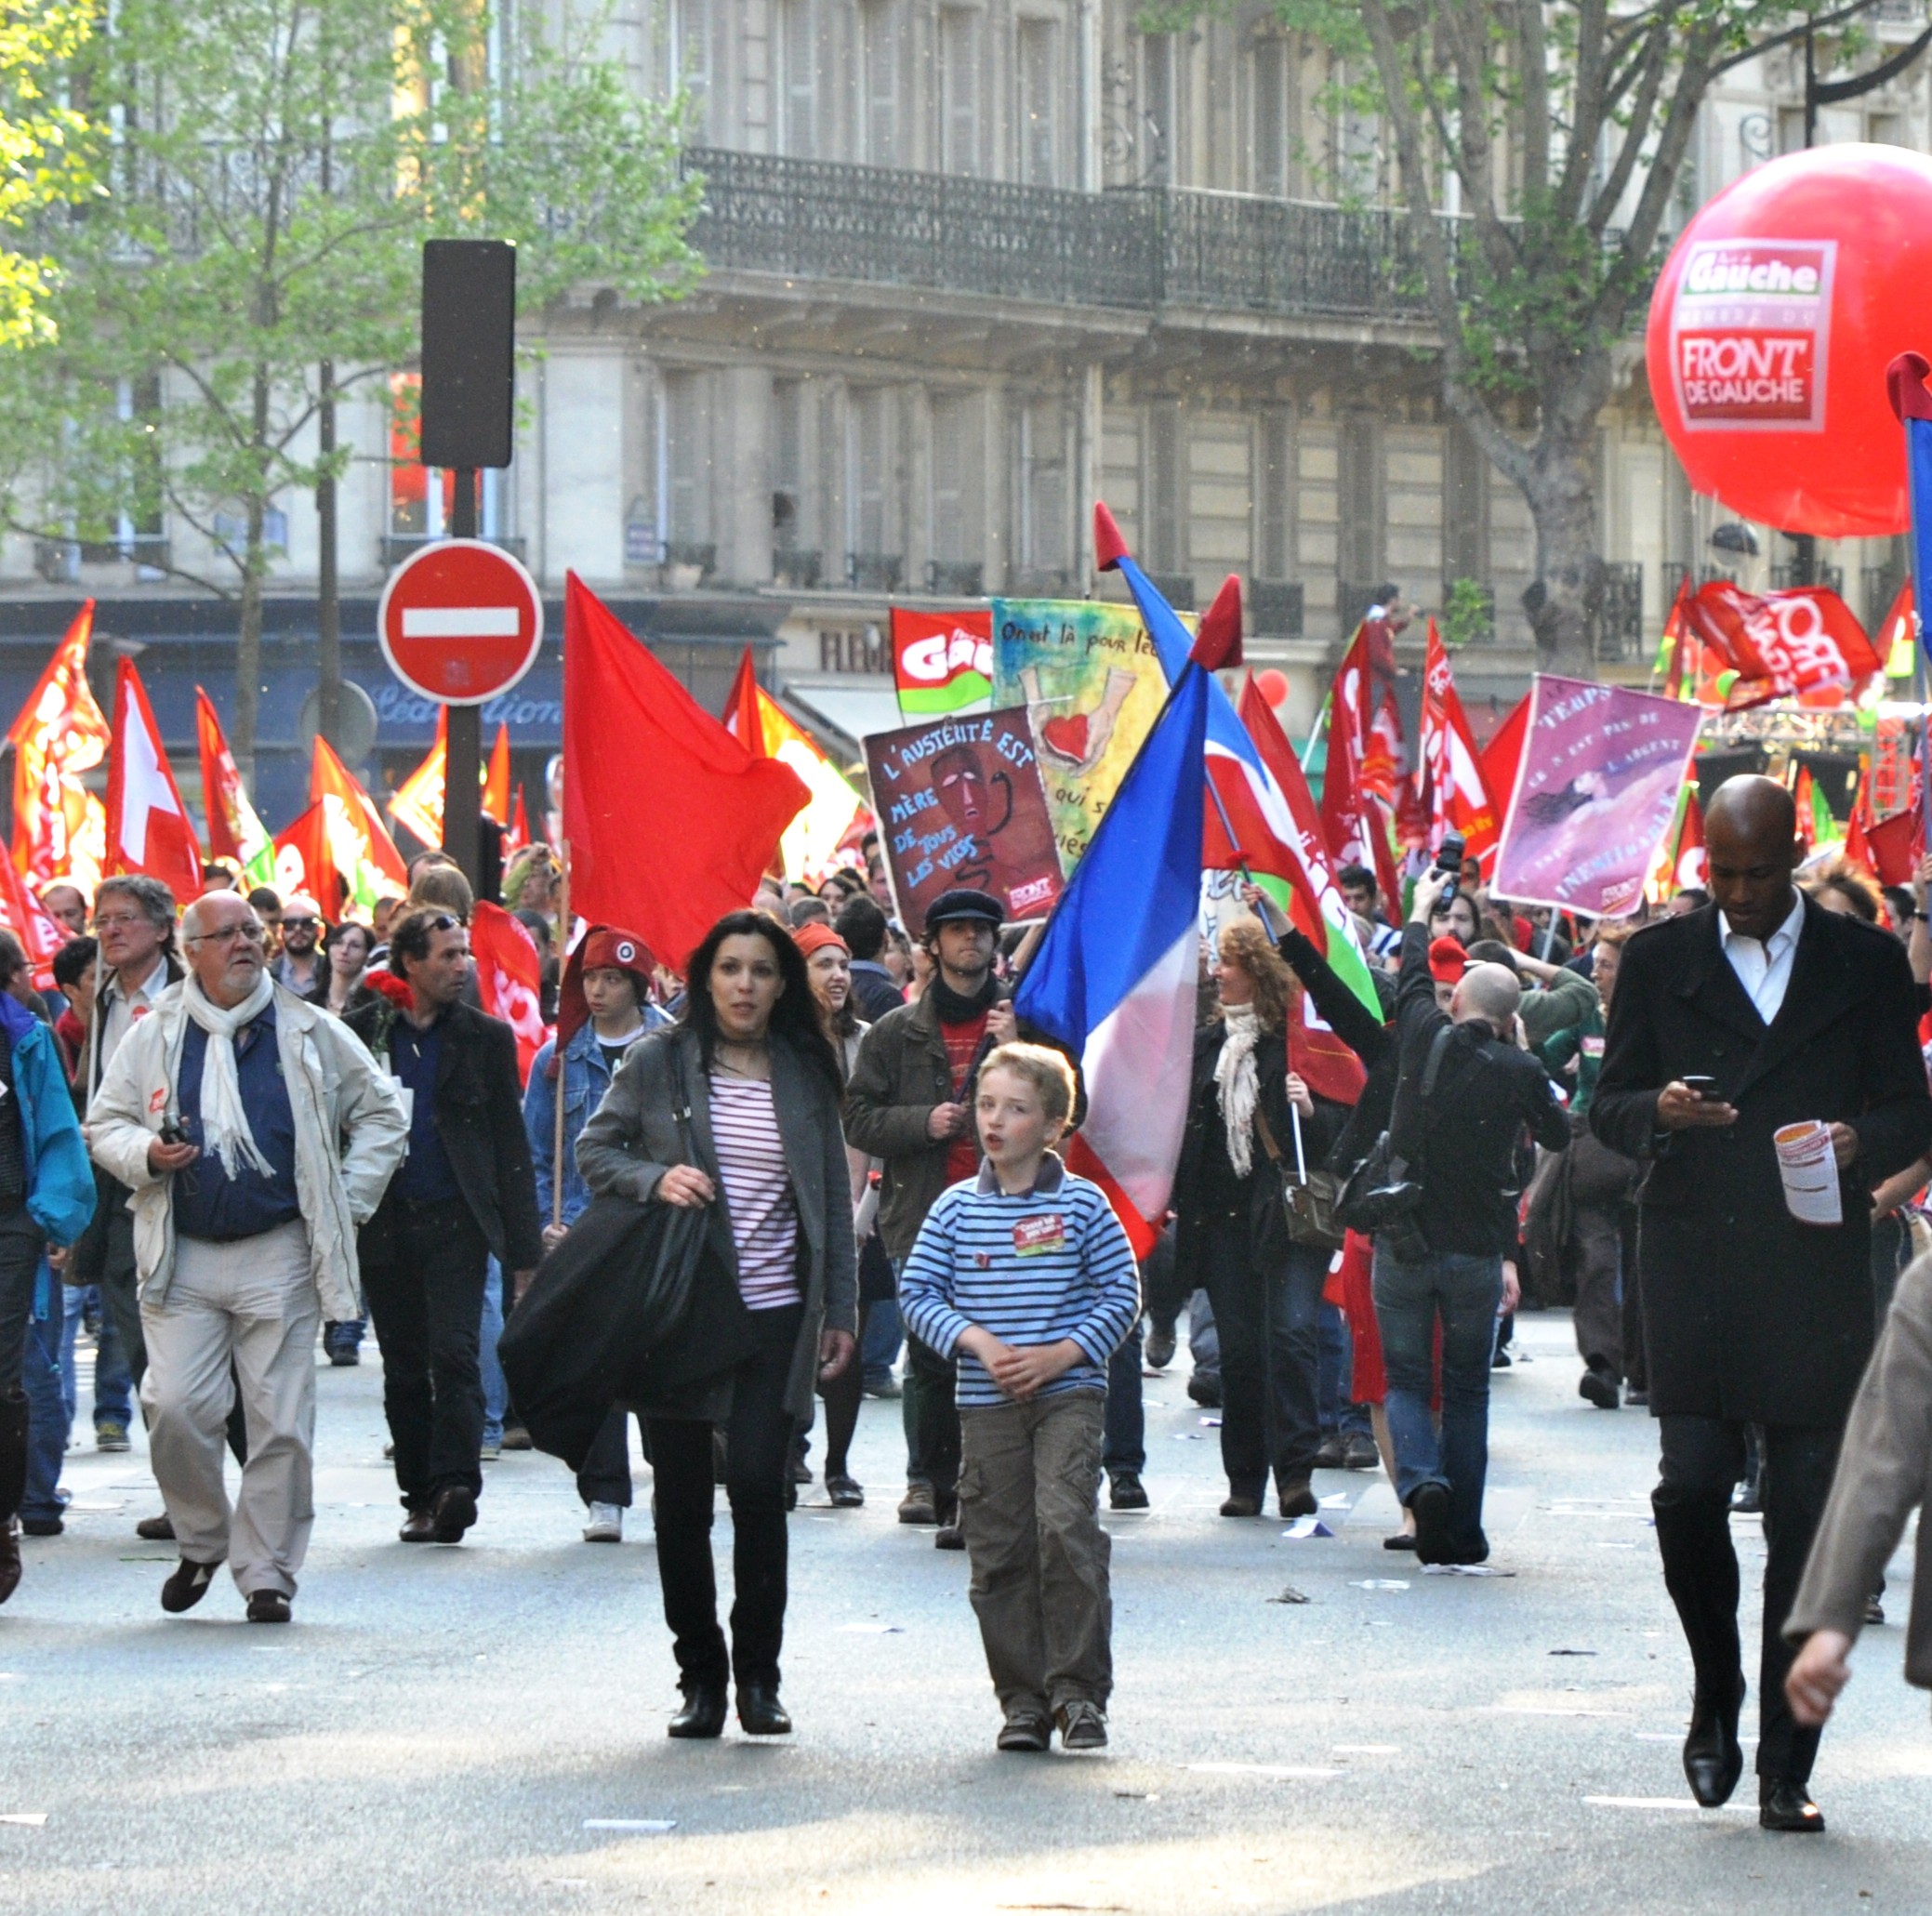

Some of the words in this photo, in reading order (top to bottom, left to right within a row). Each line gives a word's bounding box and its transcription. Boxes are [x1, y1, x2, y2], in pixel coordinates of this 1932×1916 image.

[1683, 337, 1808, 377] FRONT
[1686, 381, 1709, 404] DE
[1710, 379, 1804, 403] GAUCHE
[1060, 622, 1075, 644] là
[997, 732, 1034, 768] EST
[891, 787, 939, 824] MÈRE
[893, 826, 917, 853] DE
